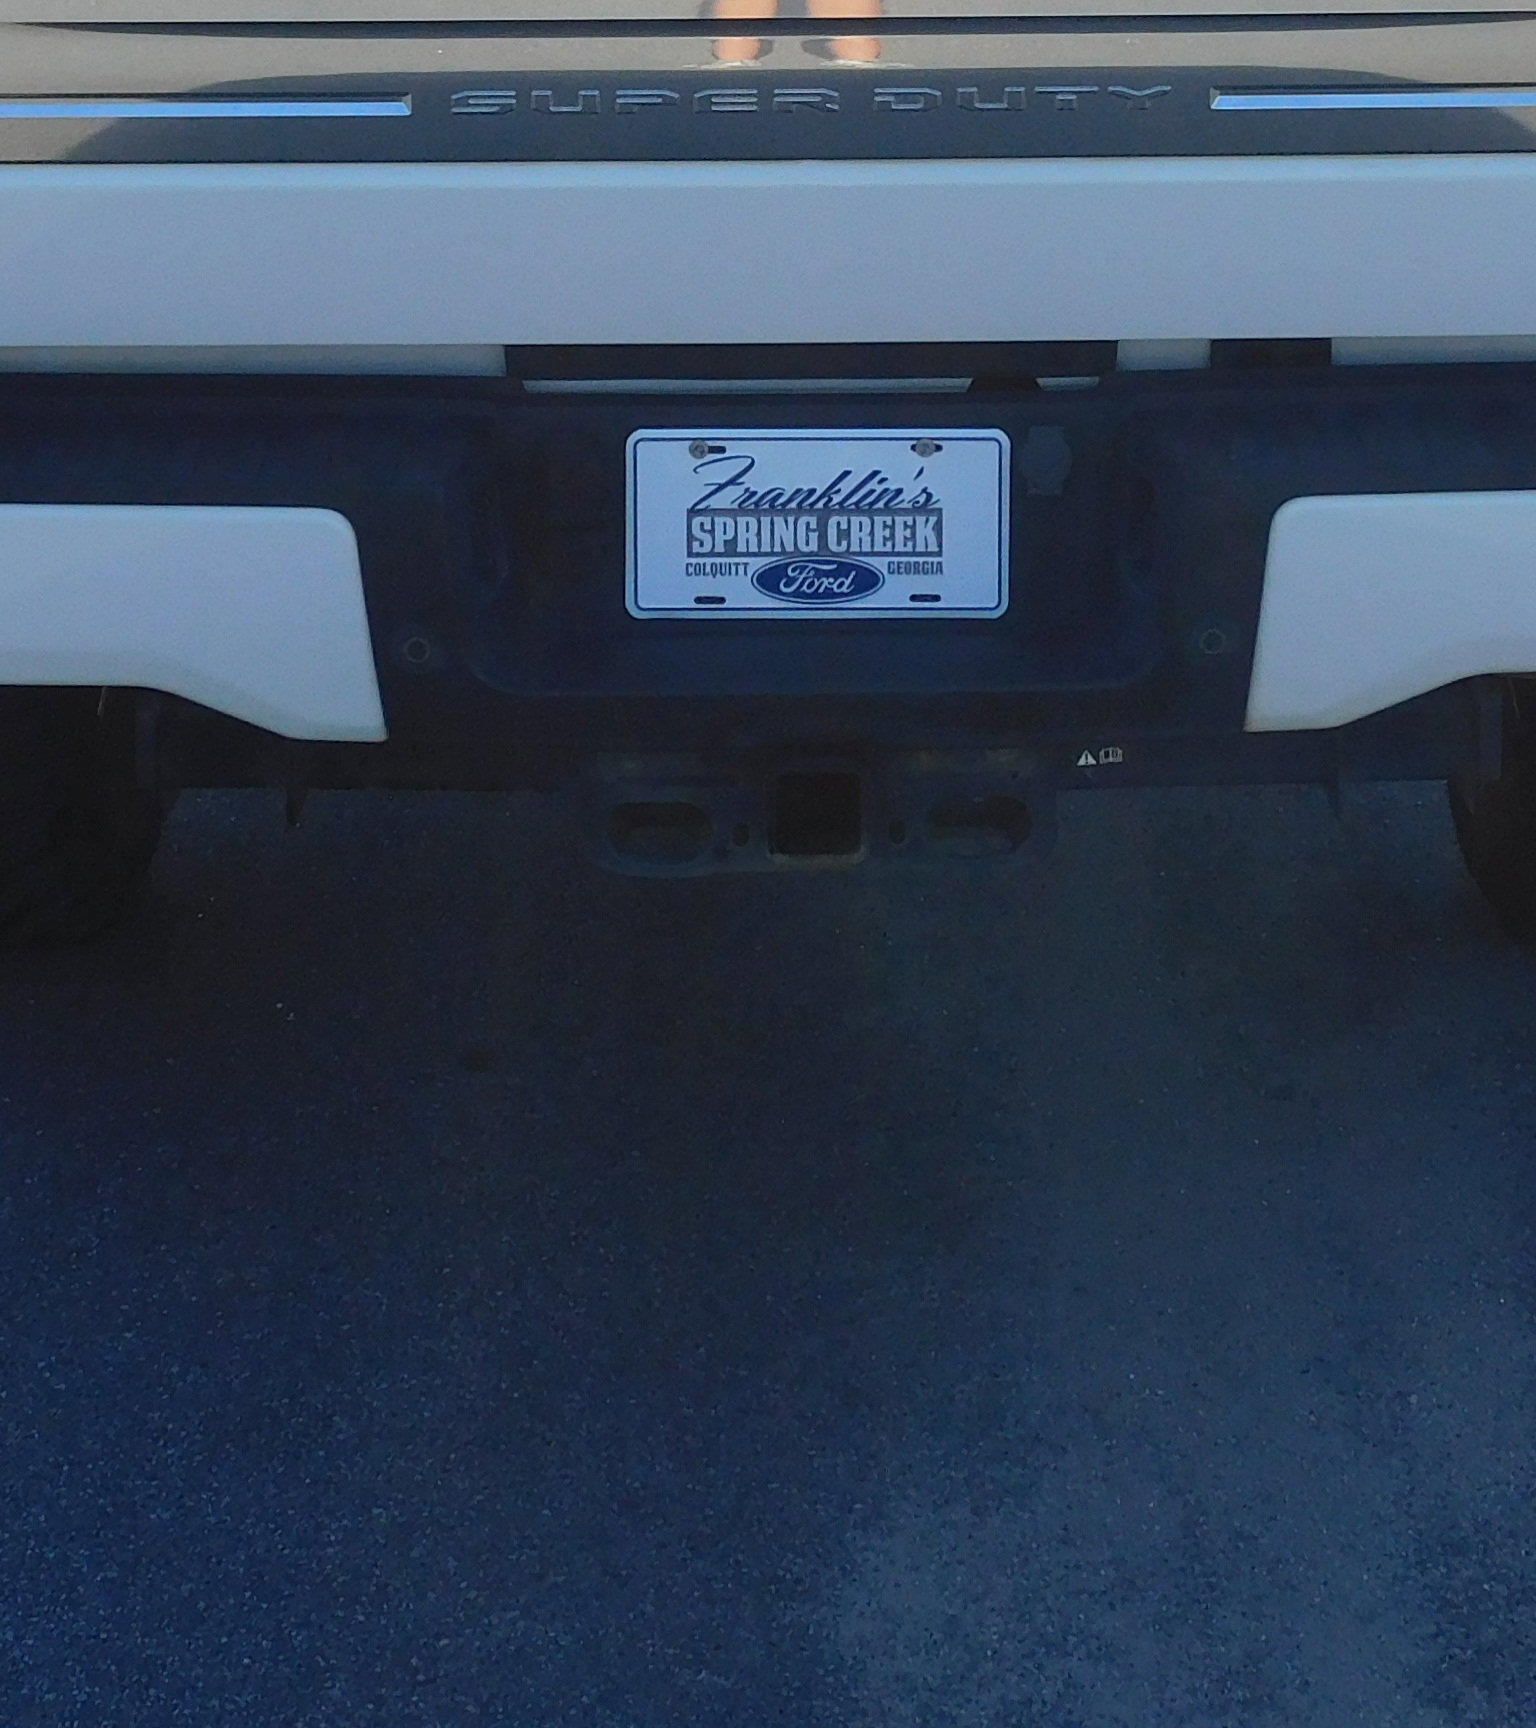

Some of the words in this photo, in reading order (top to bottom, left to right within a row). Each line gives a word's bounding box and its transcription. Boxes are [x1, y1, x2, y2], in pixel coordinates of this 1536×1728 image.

[450, 87, 841, 115] SUPER
[873, 85, 1172, 112] DUTY
[687, 455, 941, 510] Franklin's
[691, 515, 820, 554] SPRING
[826, 515, 940, 553] CREEK
[685, 562, 751, 579] COLQUITT
[779, 561, 855, 594] Ford
[887, 560, 944, 576] GEORGIA
